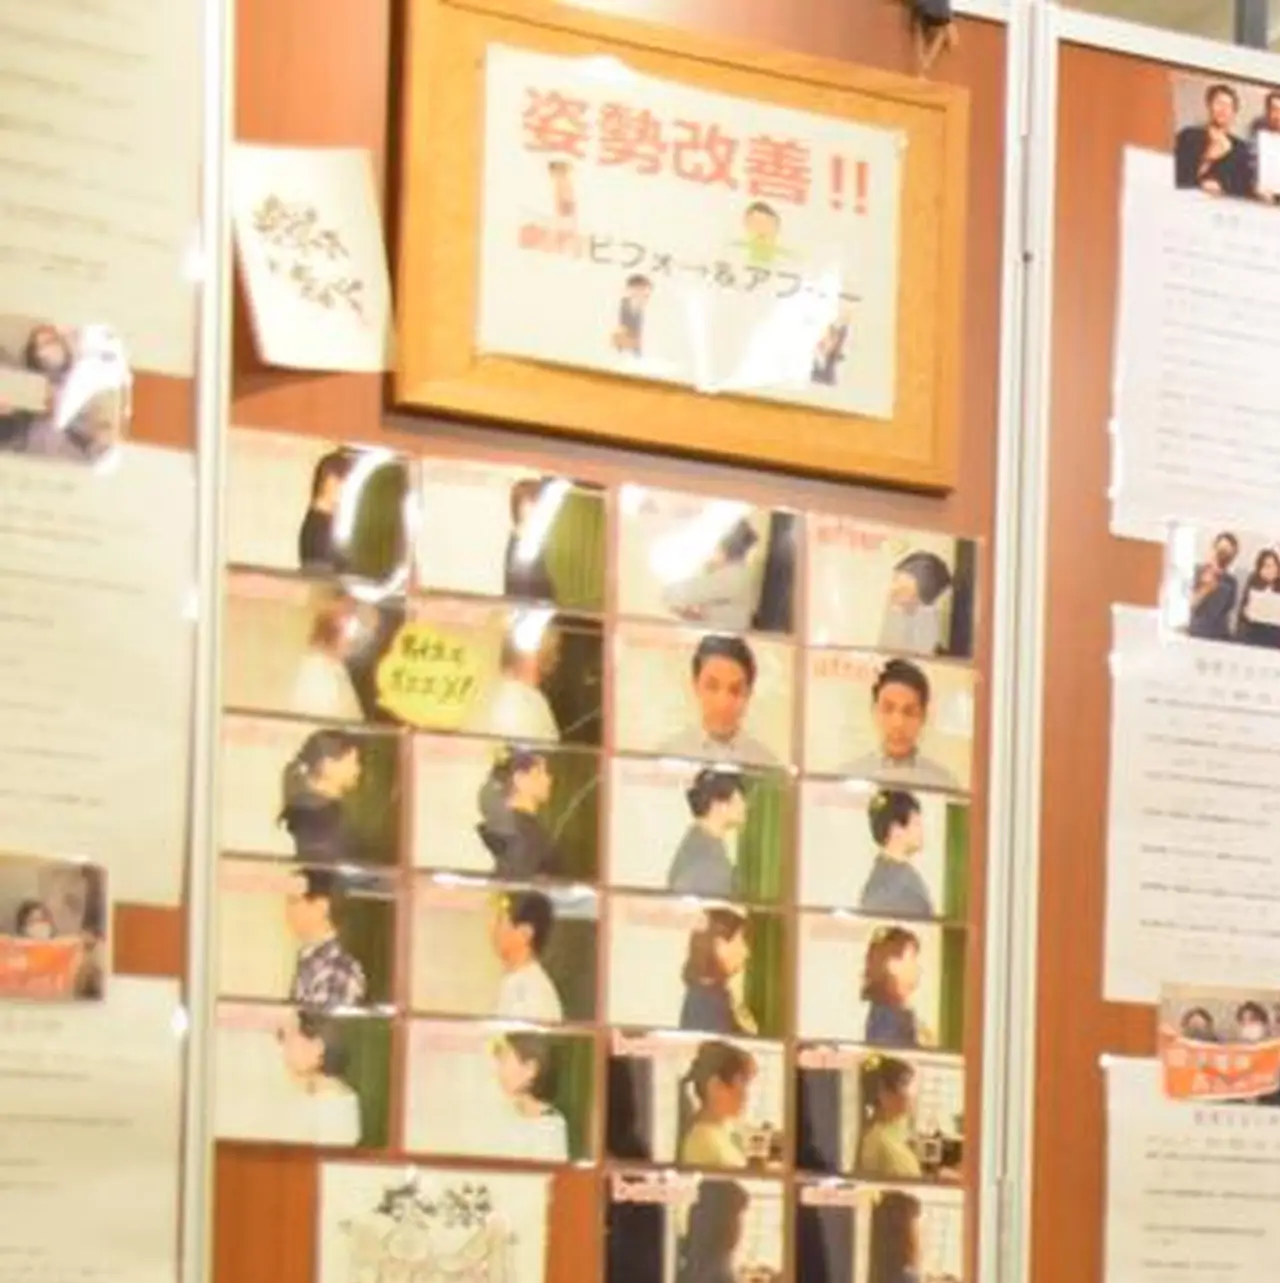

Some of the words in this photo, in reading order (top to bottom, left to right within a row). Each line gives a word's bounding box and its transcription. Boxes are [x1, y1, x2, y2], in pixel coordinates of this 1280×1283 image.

[522, 86, 868, 215] 姿勢改善!!
[518, 223, 865, 304] ビフォー&アフー
